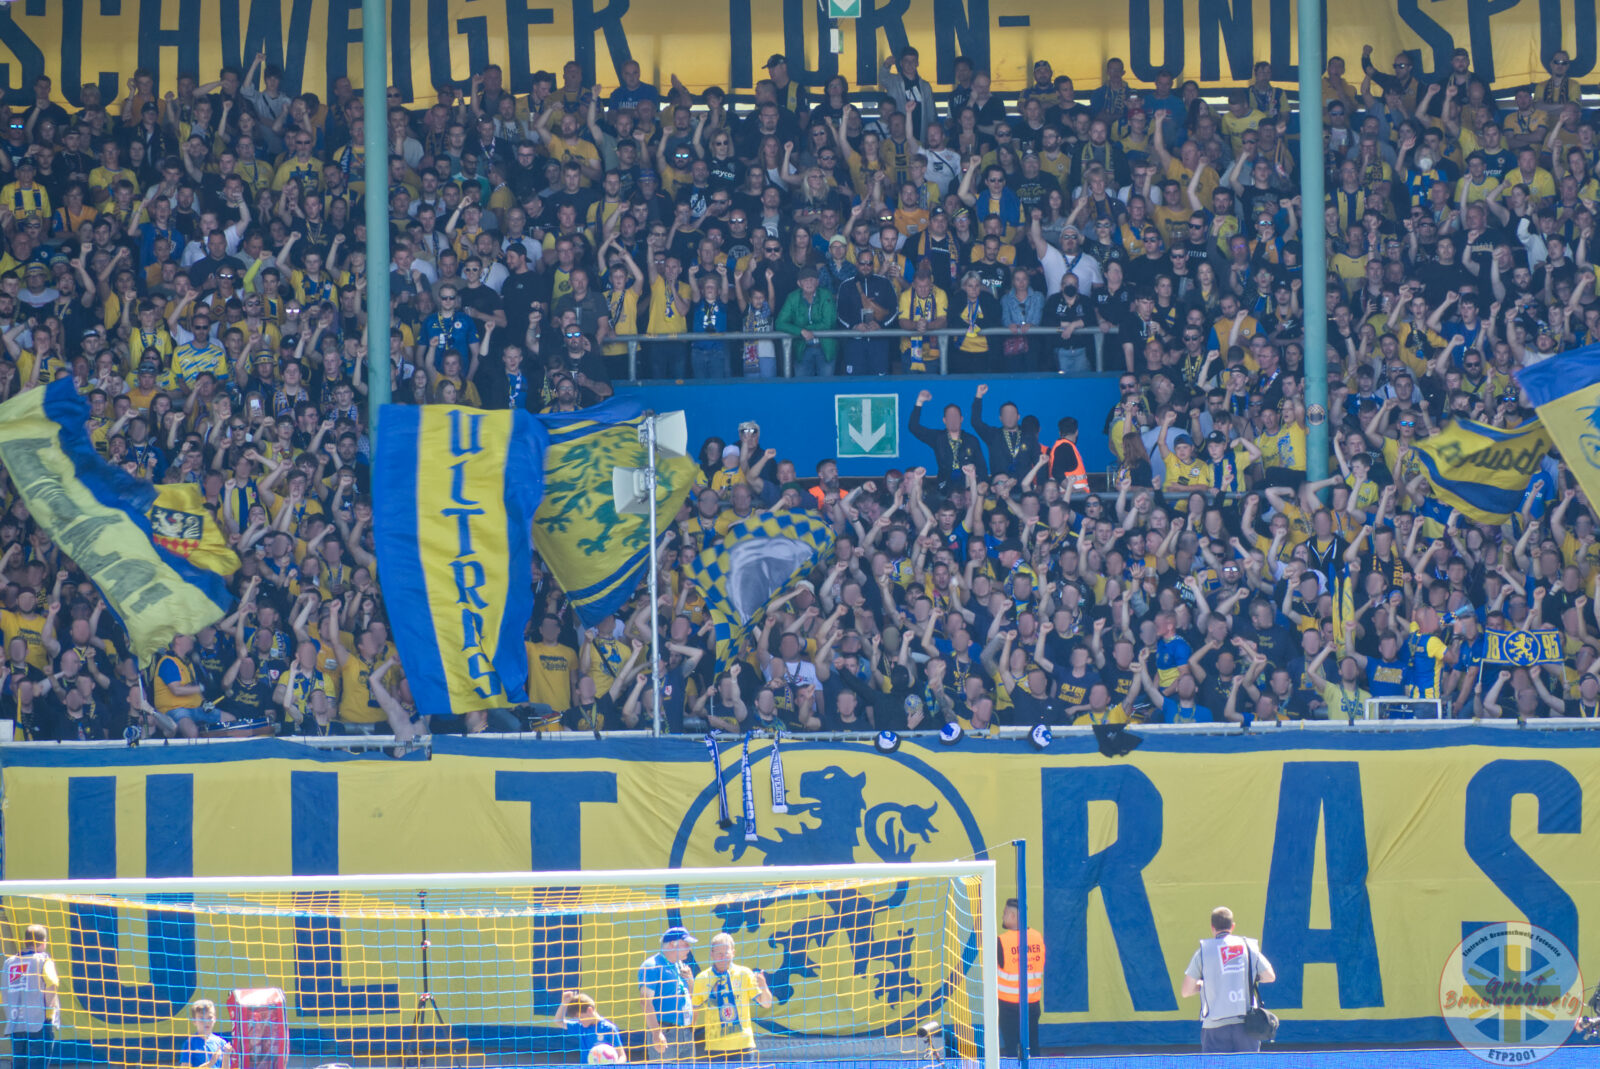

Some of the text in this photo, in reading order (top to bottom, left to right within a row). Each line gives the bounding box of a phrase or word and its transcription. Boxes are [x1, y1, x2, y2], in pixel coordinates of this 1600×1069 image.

[1487, 634, 1560, 660] 18 95
[1011, 944, 1041, 955] ONER
[1229, 988, 1246, 1003] 01
